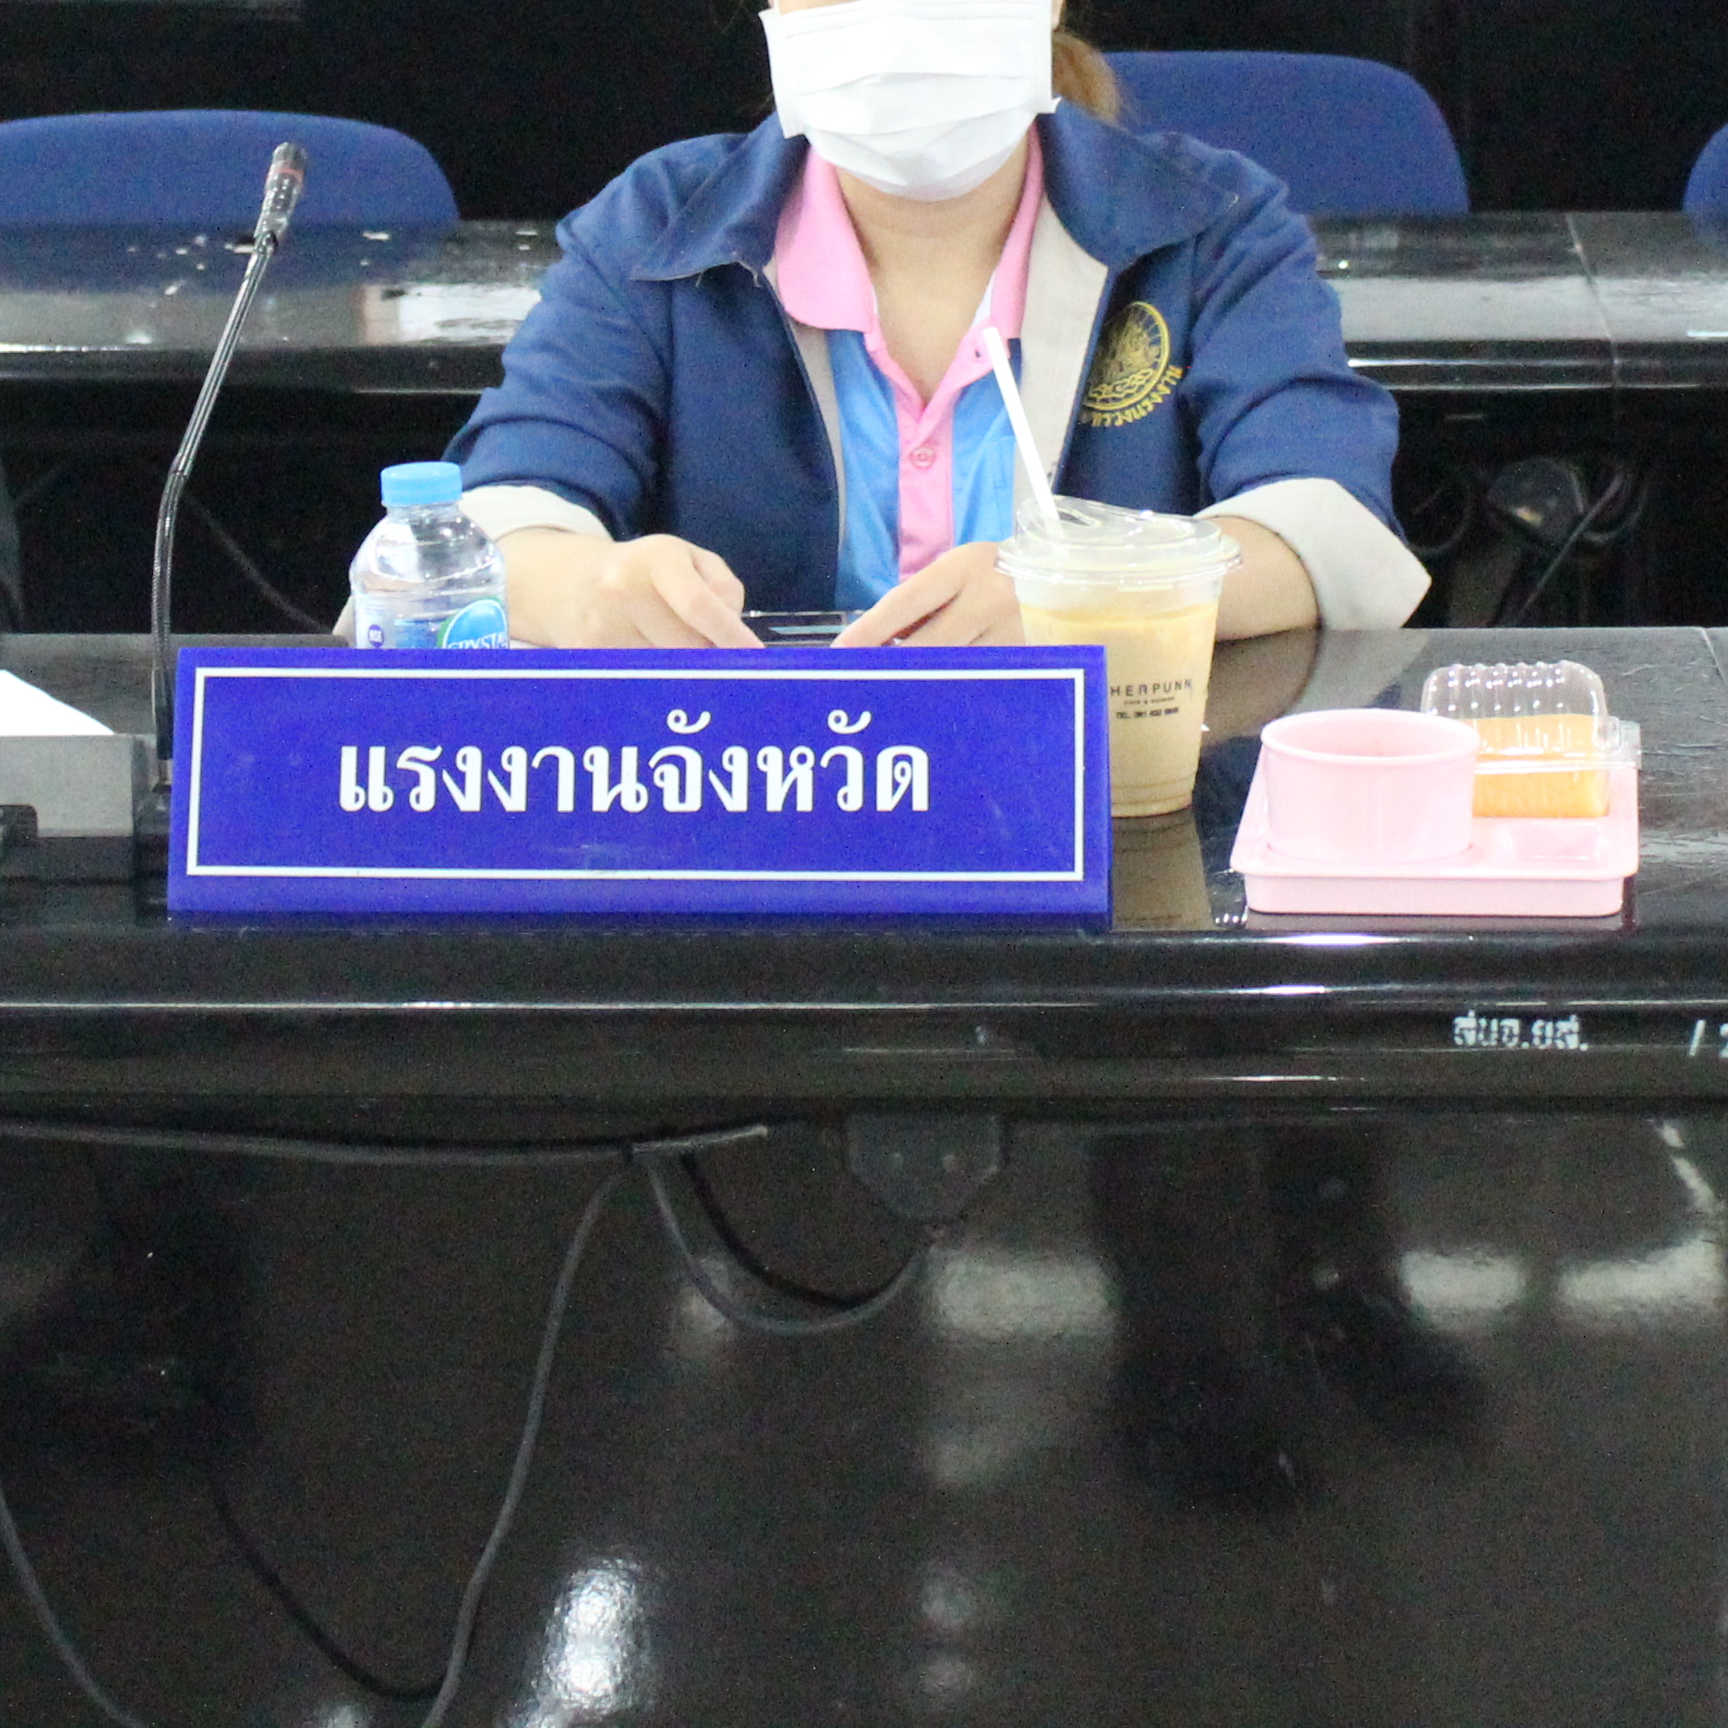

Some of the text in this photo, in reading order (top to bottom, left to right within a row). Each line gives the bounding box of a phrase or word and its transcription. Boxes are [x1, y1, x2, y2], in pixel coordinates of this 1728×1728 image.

[337, 708, 930, 813] แรงงานจังหวัด
